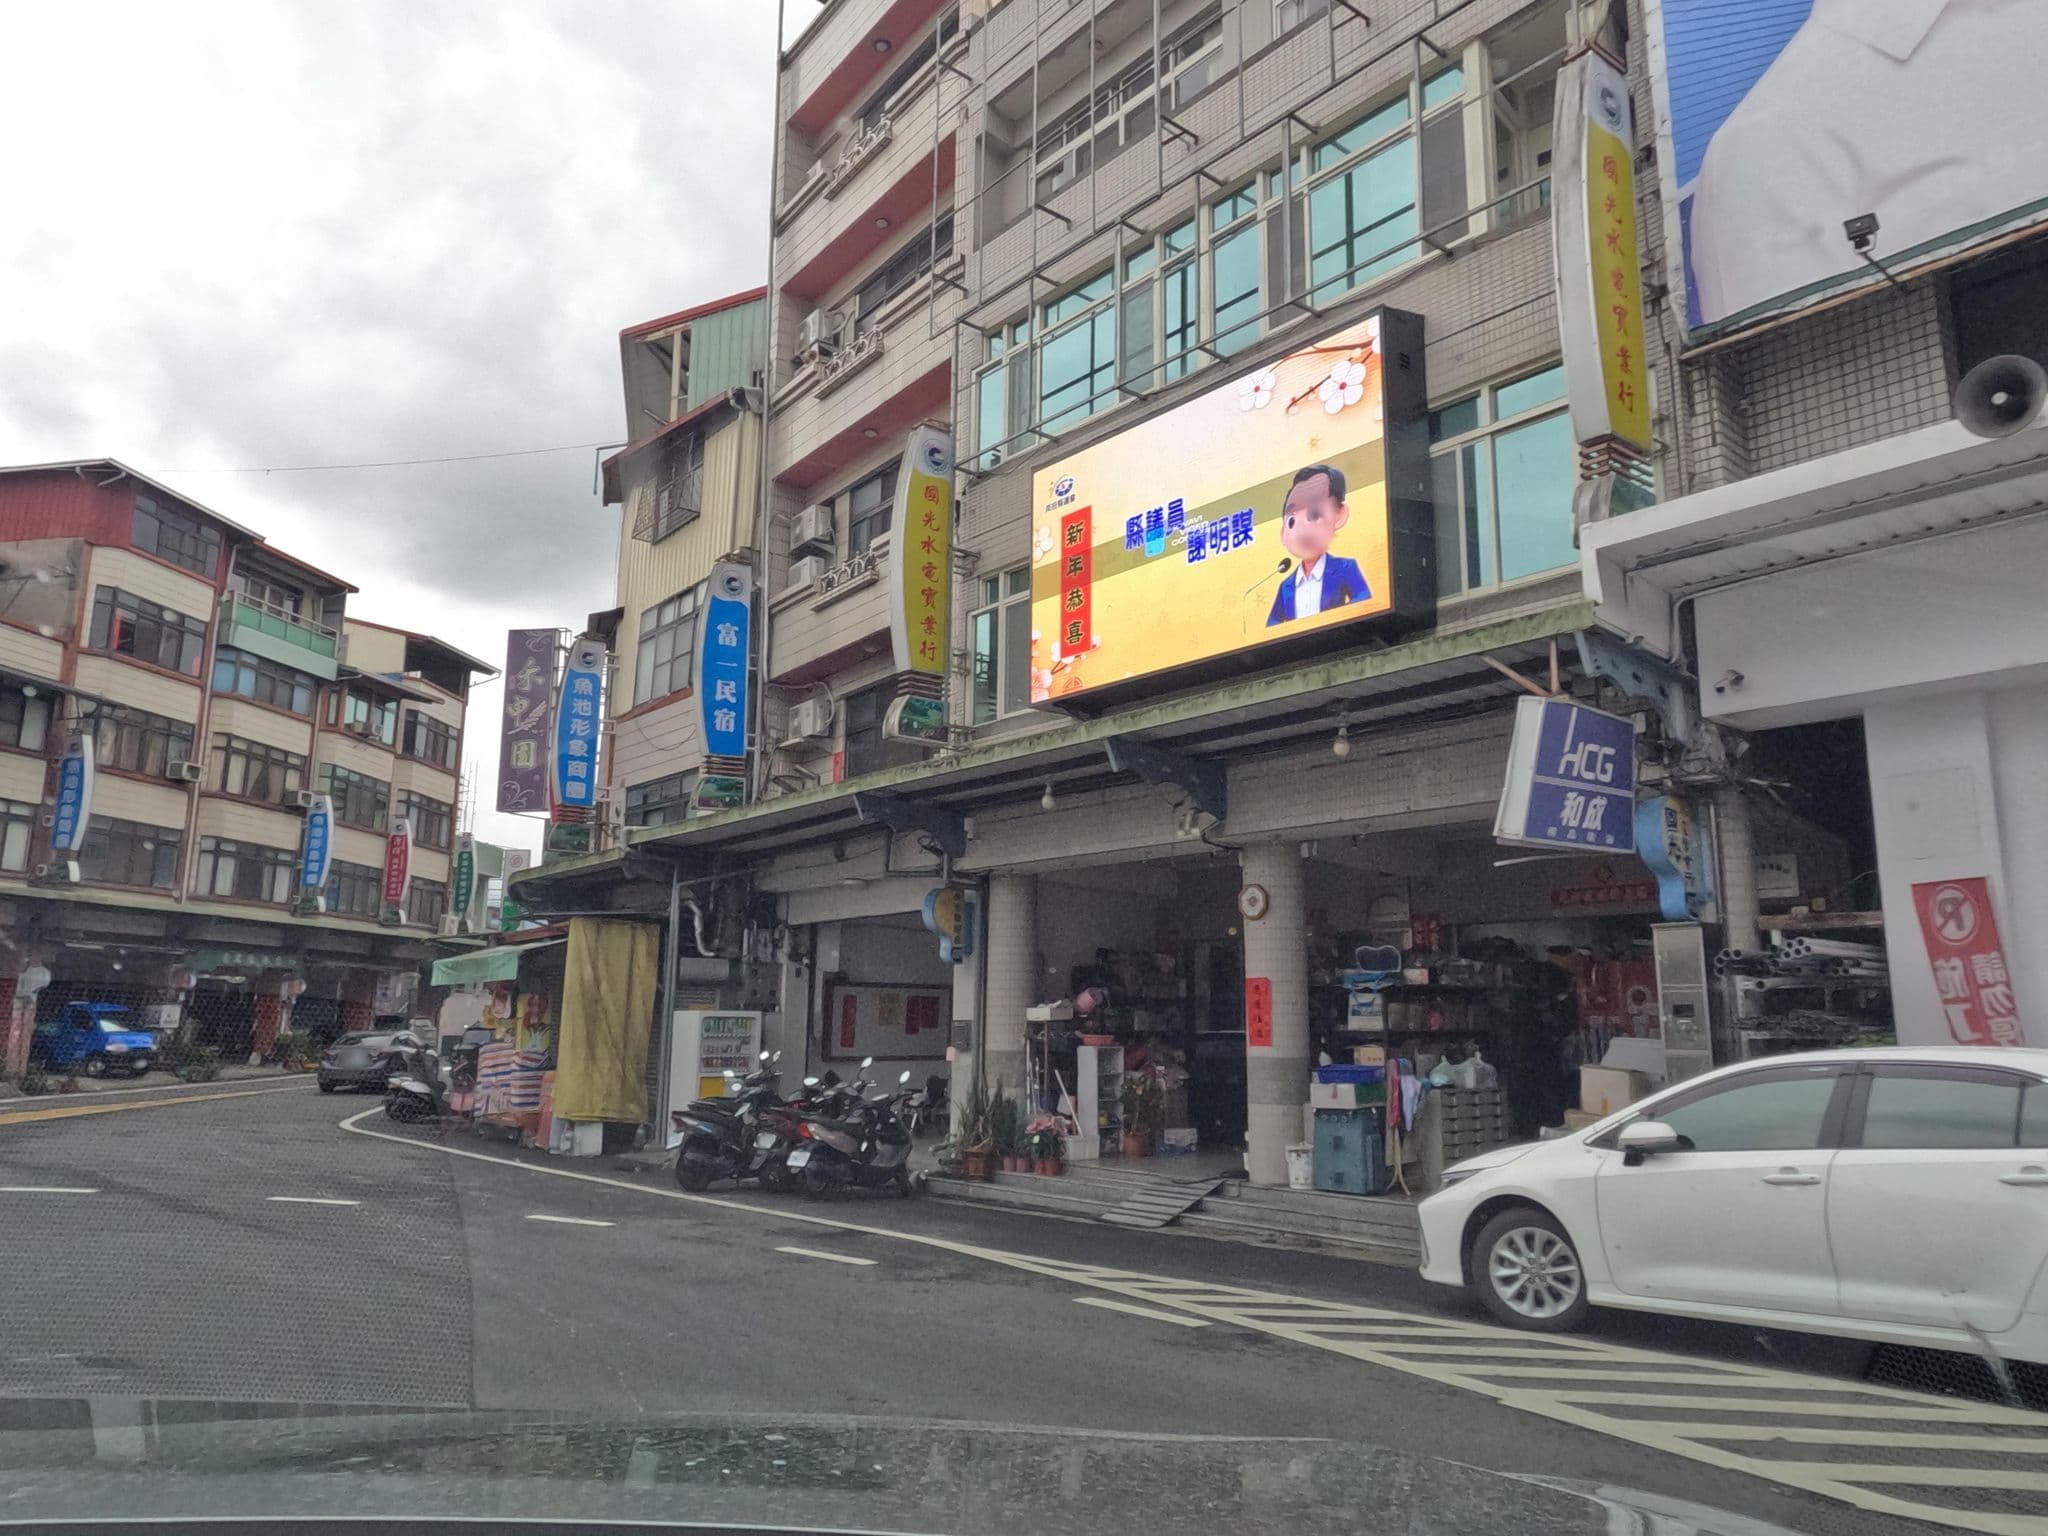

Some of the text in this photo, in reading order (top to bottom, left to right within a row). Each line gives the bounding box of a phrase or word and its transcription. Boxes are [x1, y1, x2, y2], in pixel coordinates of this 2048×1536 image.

[1065, 520, 1085, 645] 新年恭喜
[712, 622, 739, 733] 富一民宿
[1557, 706, 1616, 783] HCG
[1560, 791, 1608, 831] 和成
